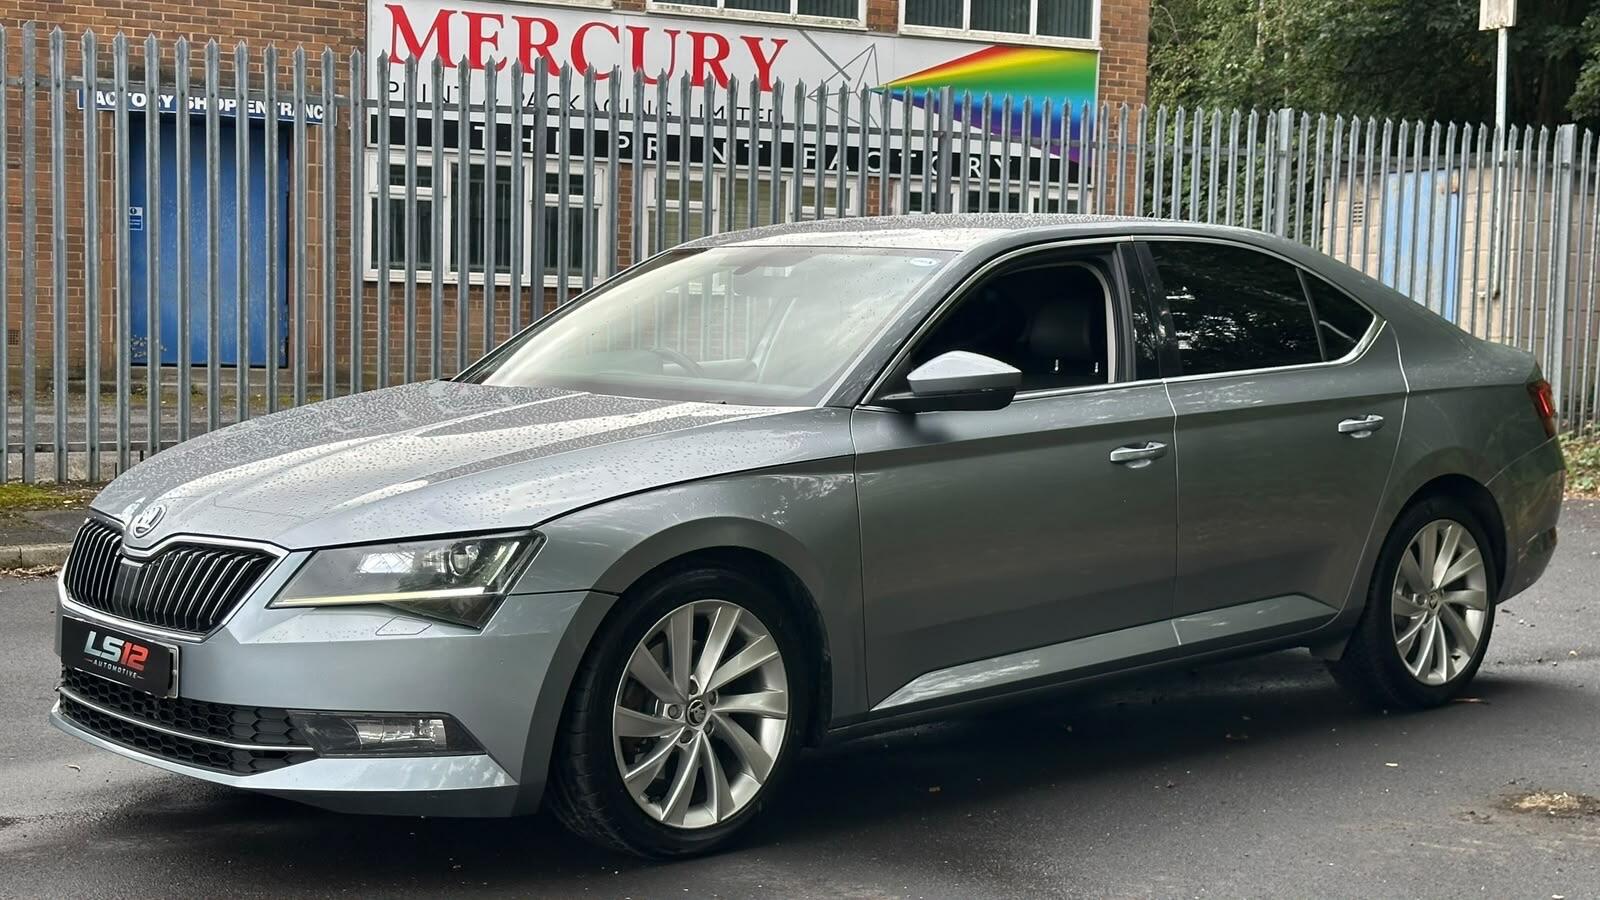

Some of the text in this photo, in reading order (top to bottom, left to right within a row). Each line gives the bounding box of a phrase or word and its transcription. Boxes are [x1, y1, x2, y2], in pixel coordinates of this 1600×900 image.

[385, 4, 788, 92] MERCURY
[87, 90, 174, 108] ACOY
[84, 630, 149, 671] LS12
[93, 660, 137, 679] AUTOMOTIVE
